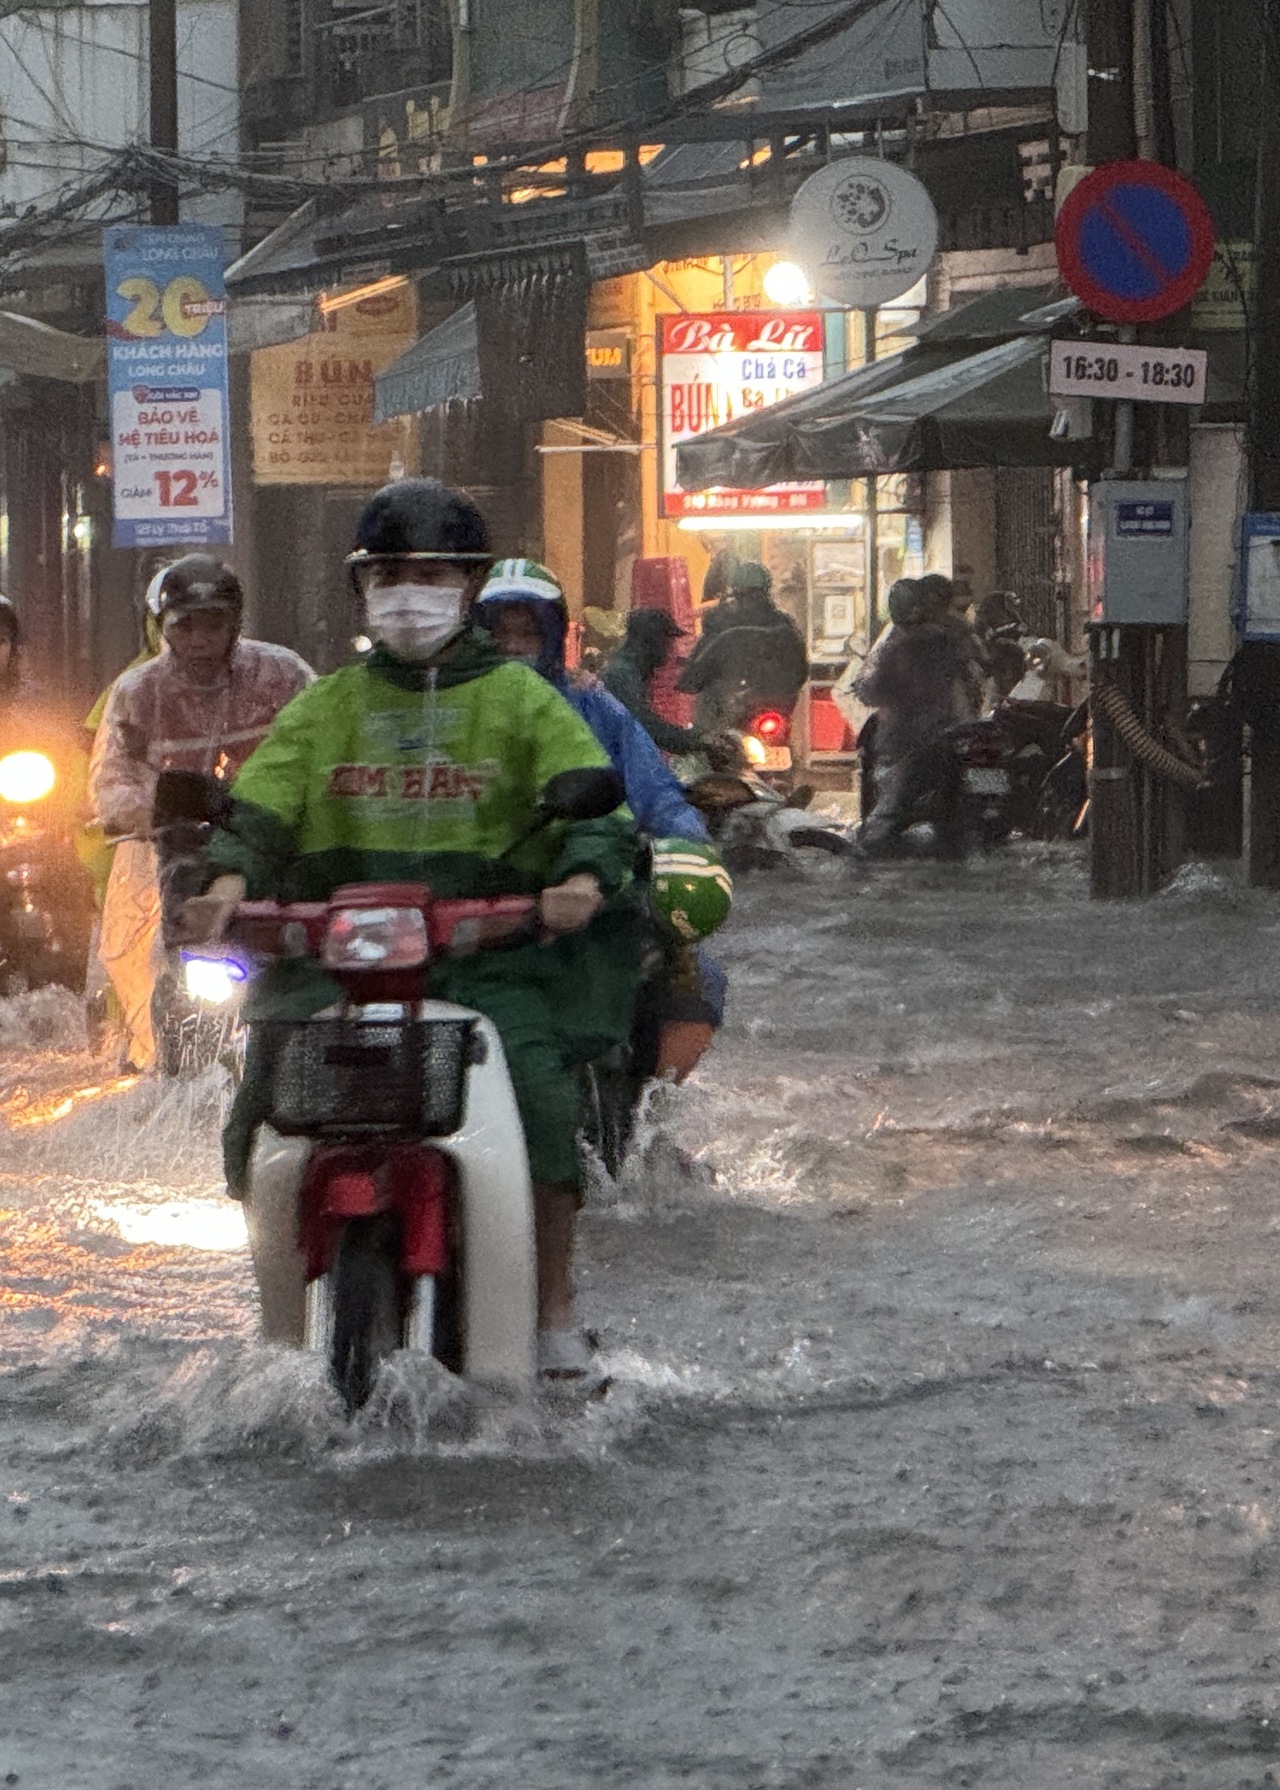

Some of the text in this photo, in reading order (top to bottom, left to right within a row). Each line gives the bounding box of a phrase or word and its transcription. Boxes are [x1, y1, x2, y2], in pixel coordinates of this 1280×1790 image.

[115, 275, 211, 339] 20
[113, 340, 223, 360] KHÁCH HÀNG
[128, 361, 206, 377] LONG CHÂU
[295, 354, 373, 384] BÚN
[741, 356, 807, 381] Chả Cá
[1063, 356, 1119, 382] 16:30
[1141, 361, 1195, 388] 18:30
[138, 406, 173, 425] BẢO
[144, 427, 181, 445] TIÊU
[154, 470, 219, 507] 12%
